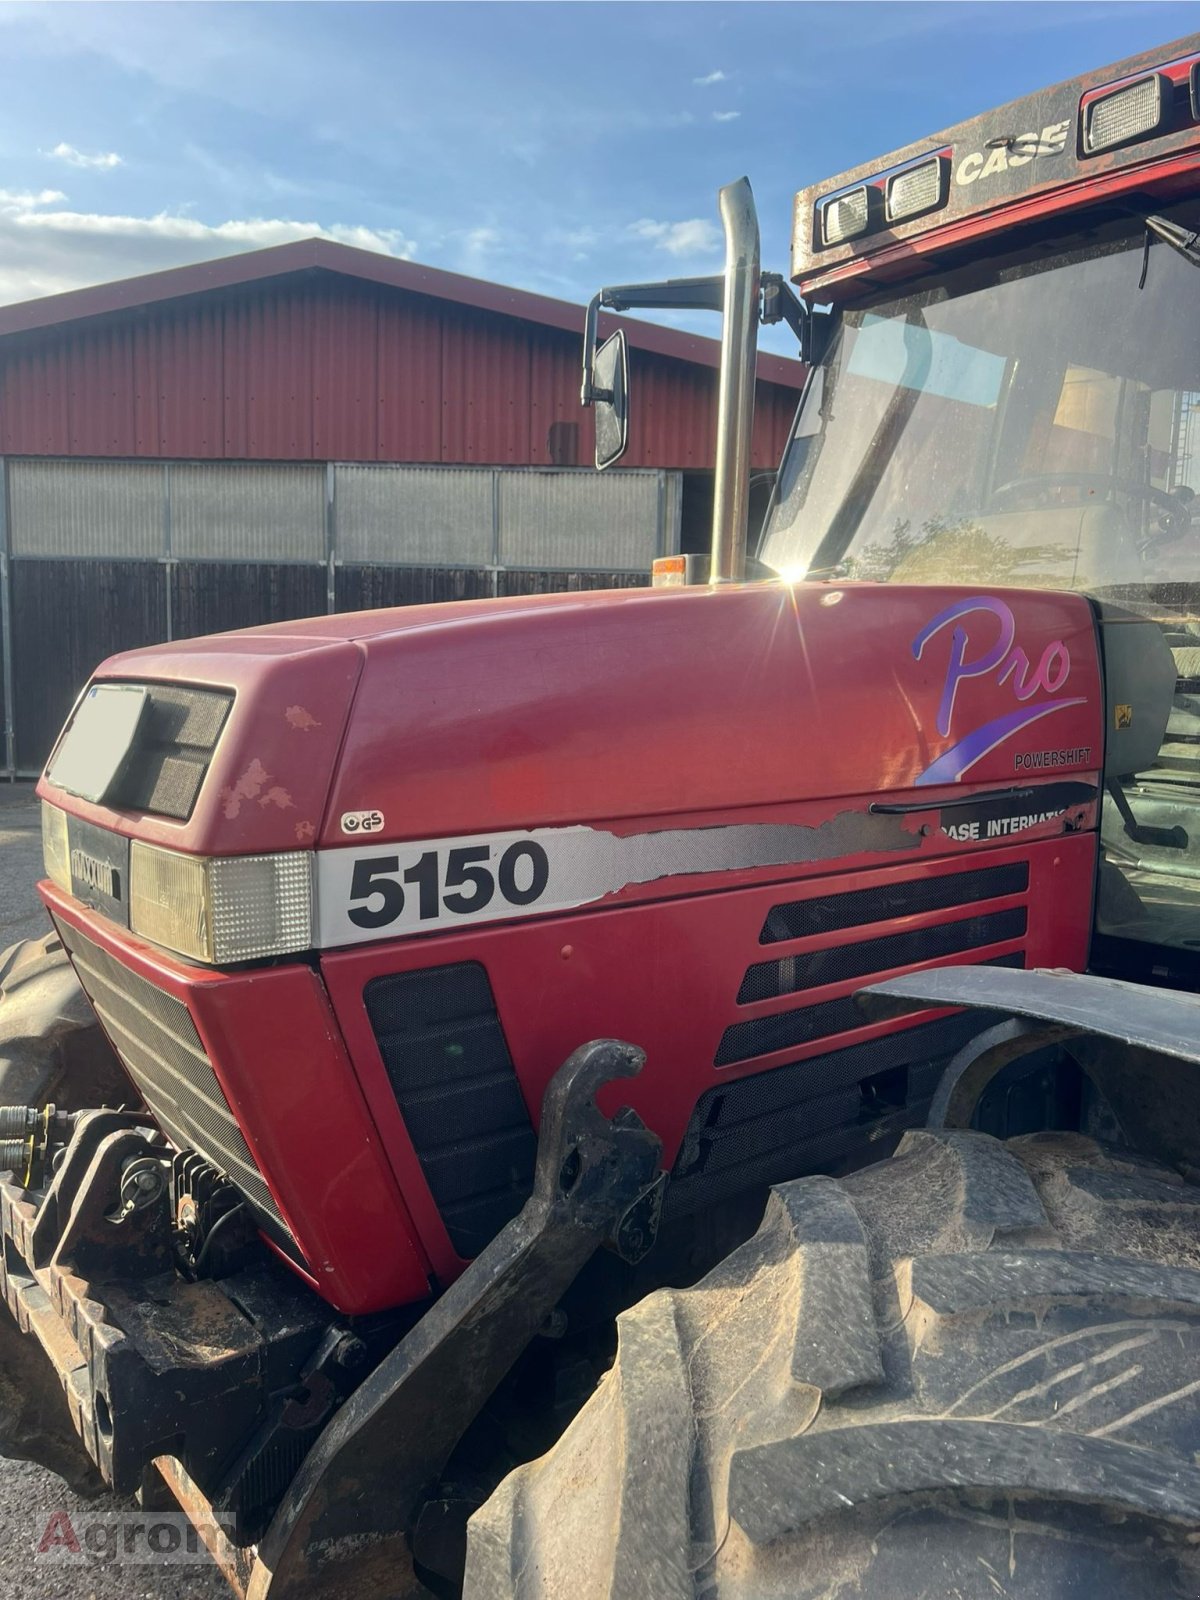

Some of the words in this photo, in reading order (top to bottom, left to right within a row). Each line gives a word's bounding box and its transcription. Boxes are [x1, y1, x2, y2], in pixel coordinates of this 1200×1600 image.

[956, 119, 1071, 185] CASE
[911, 595, 1071, 738] Pro
[1014, 747, 1092, 771] POWERSHIFT
[362, 812, 382, 830] GS
[941, 822, 980, 841] ASE
[347, 840, 549, 929] 5150
